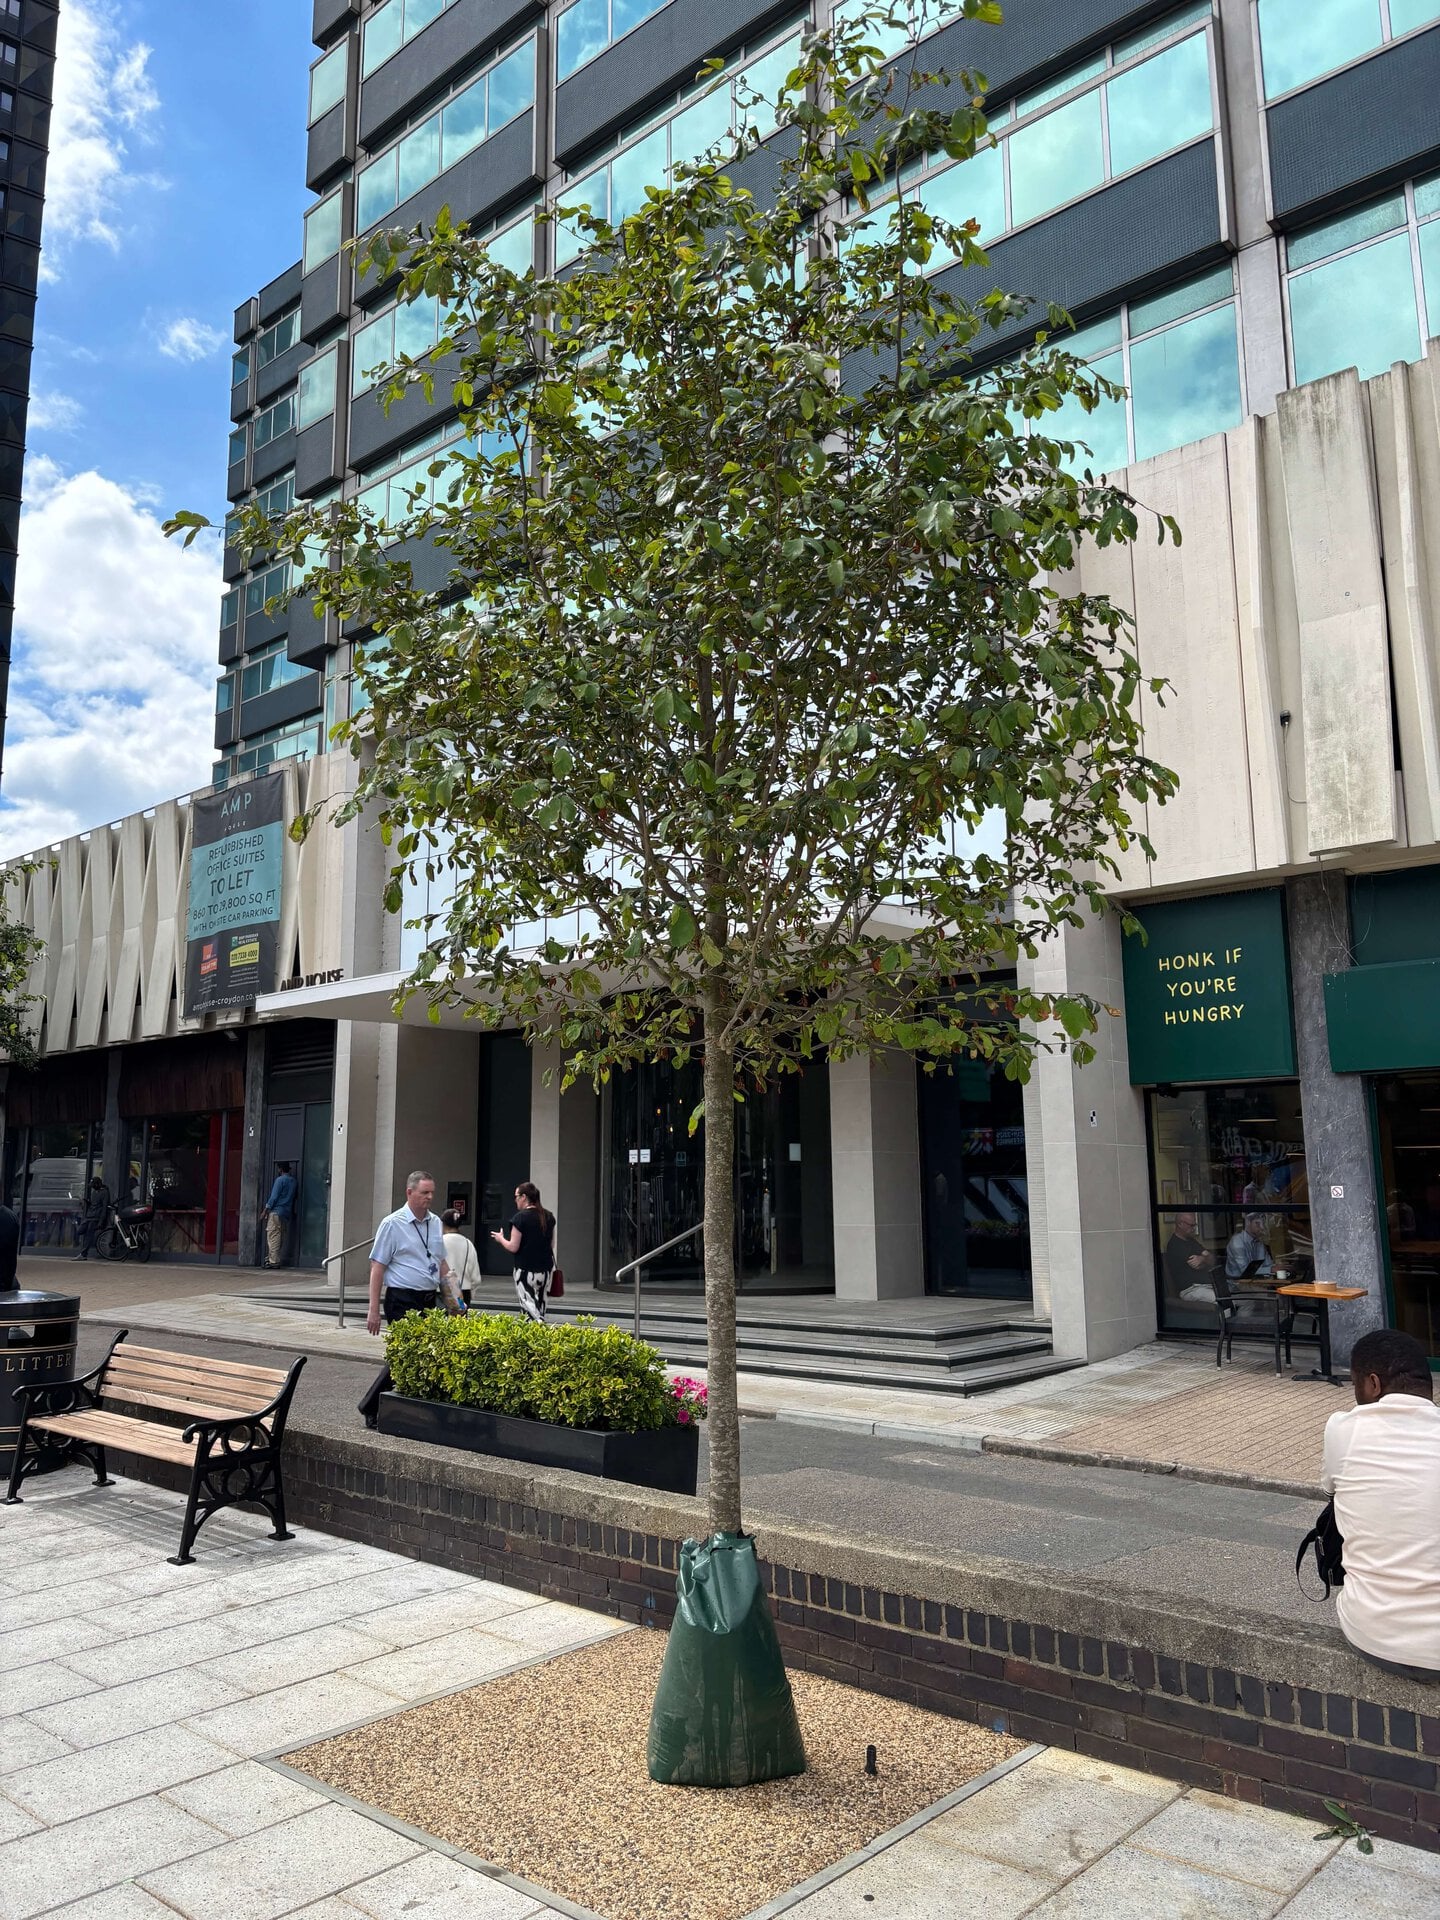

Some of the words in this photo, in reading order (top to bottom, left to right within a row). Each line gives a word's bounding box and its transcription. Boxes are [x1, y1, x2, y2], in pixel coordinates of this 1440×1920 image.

[221, 792, 252, 818] AMP
[209, 834, 264, 860] REFURBISHED
[207, 858, 231, 876] OFFICE
[233, 850, 265, 866] SUITES
[210, 878, 226, 897] TO
[228, 869, 254, 891] LET
[208, 904, 218, 915] TO
[249, 892, 263, 904] SQ
[266, 889, 276, 901] FT
[228, 912, 241, 923] CAR
[242, 906, 273, 919] PARKING
[1158, 952, 1215, 971] HONK
[1225, 947, 1242, 964] IF
[1166, 976, 1237, 998] YOU'RE
[1164, 1003, 1245, 1025] HUNGRY
[5, 1353, 72, 1372] LITTER
